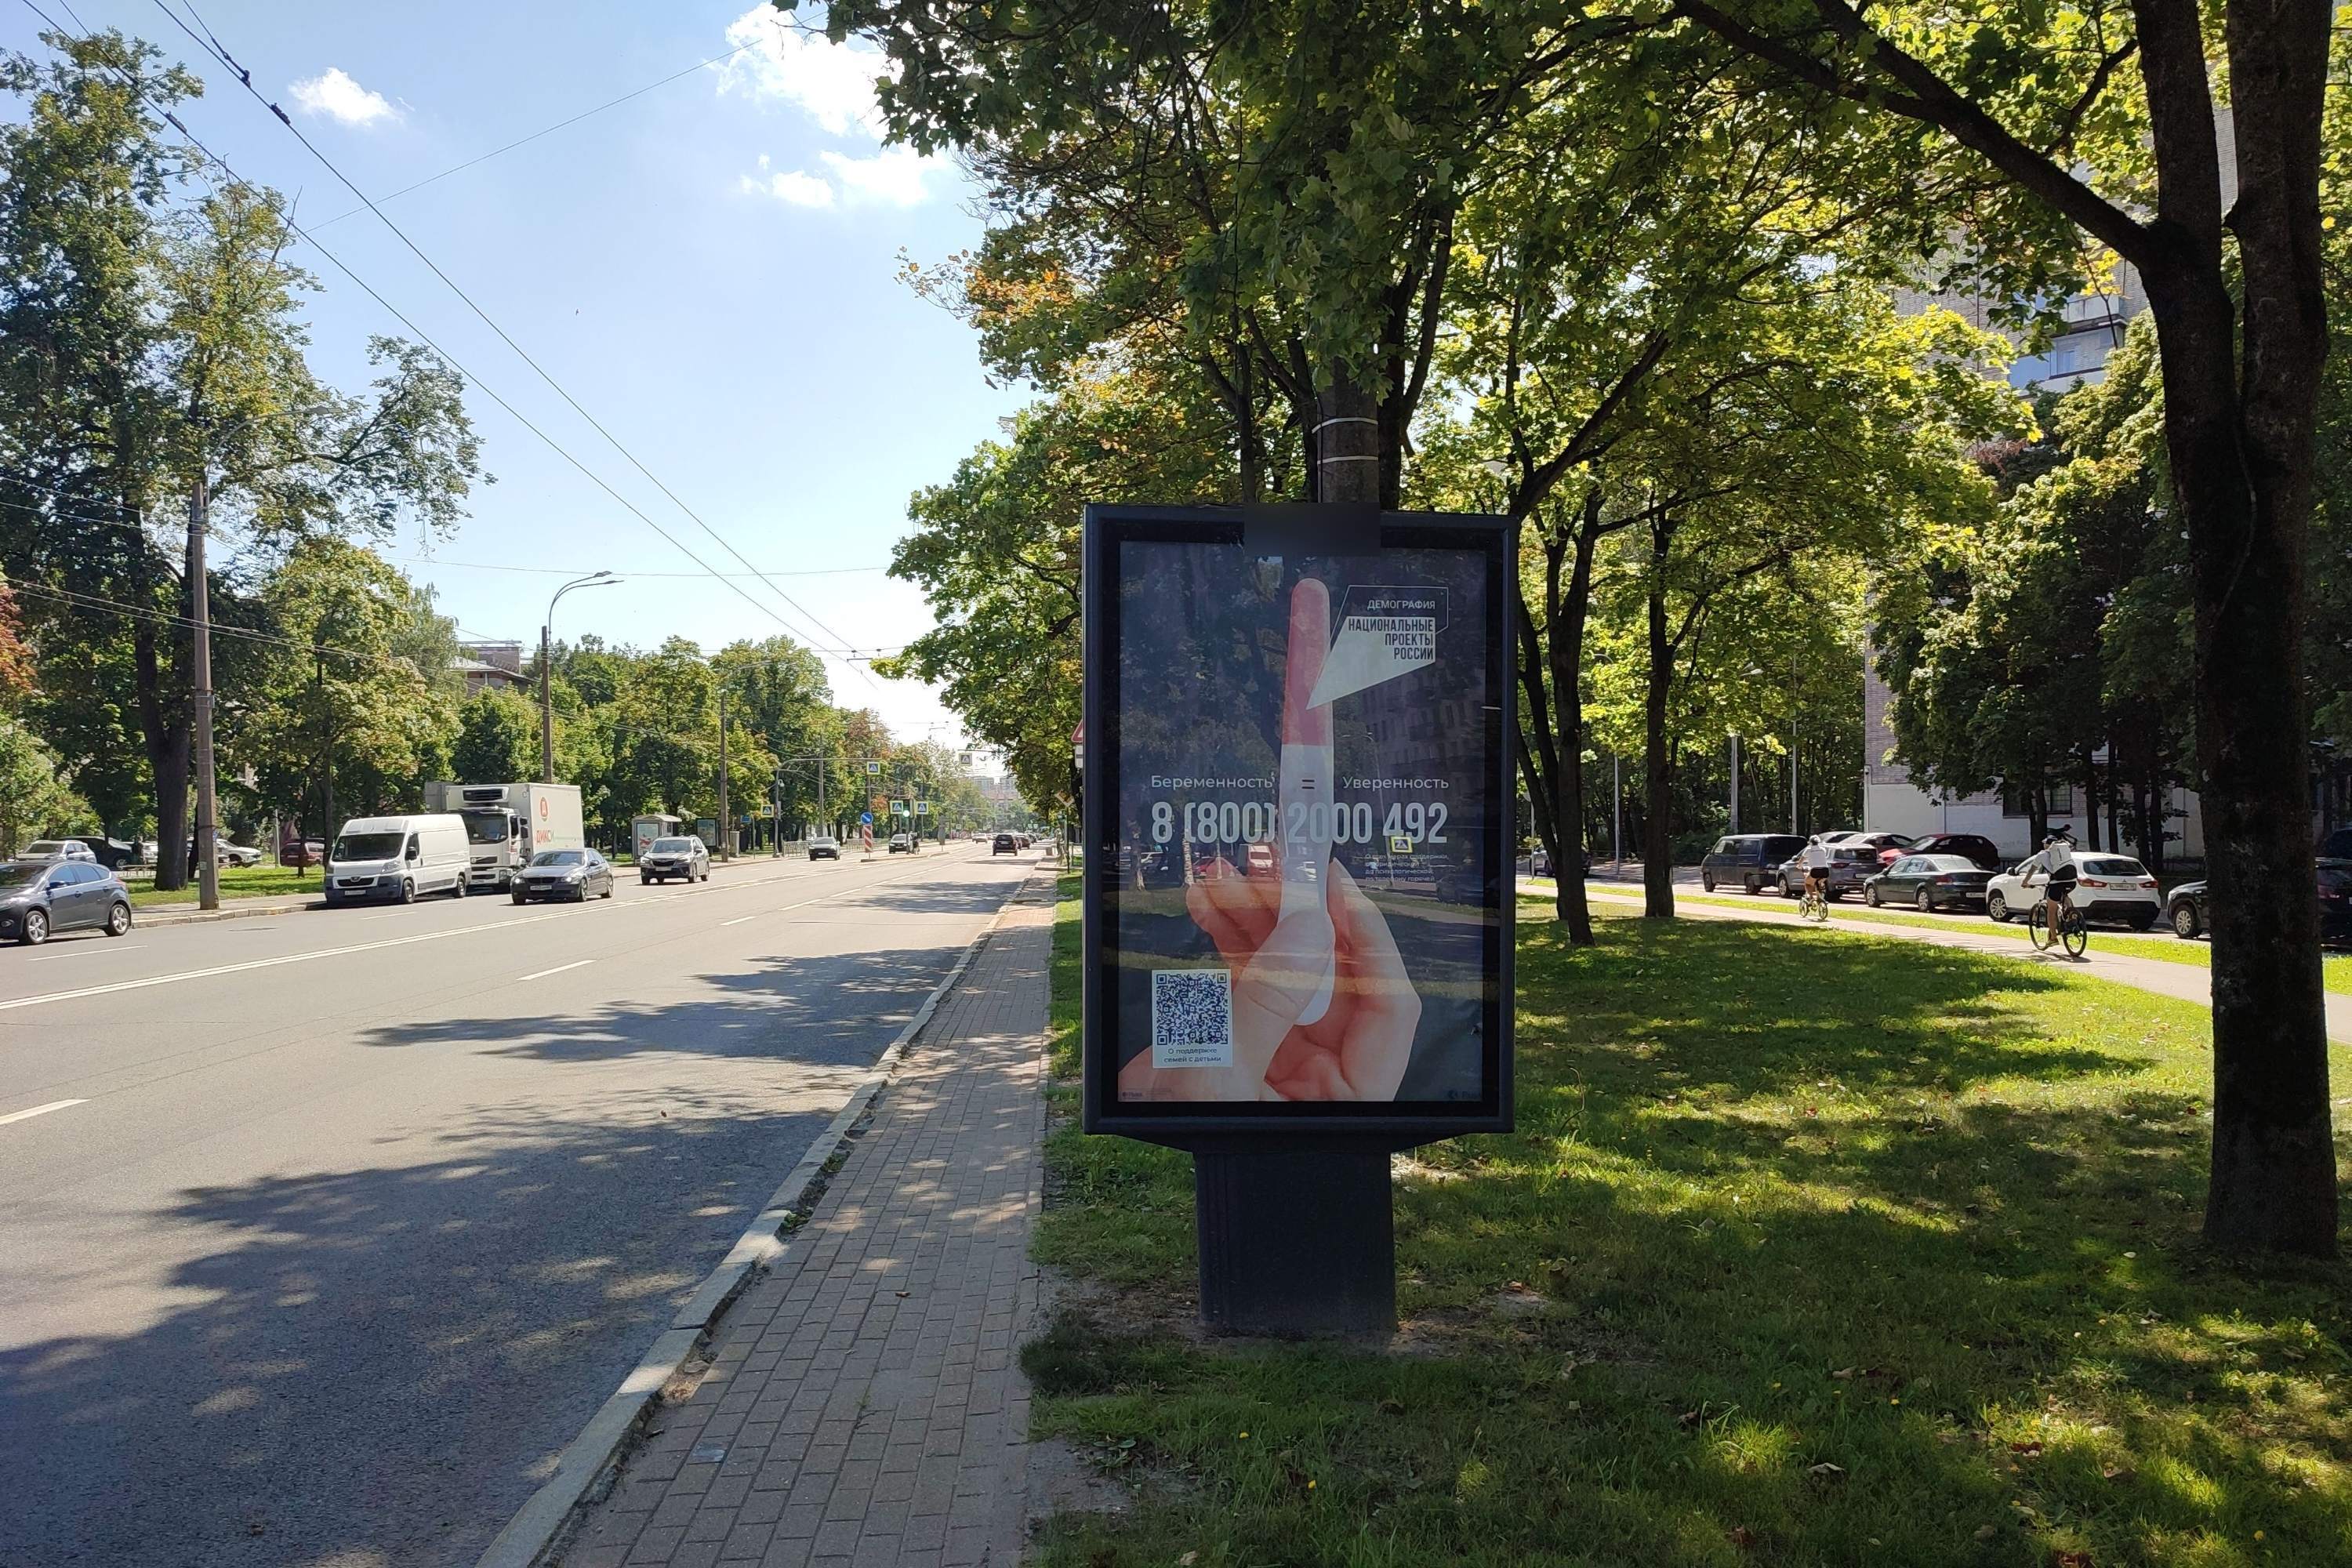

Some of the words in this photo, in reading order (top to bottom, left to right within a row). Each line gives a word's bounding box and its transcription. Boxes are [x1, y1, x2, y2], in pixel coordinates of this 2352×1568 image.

[1367, 600, 1436, 610] ДЕМОГРАФИЯ
[1348, 619, 1434, 633] НАЦИОНАЛЬНЫЕ
[1385, 633, 1434, 646] ПРОЕКТЫ
[1393, 647, 1434, 660] РОССИИ
[1151, 775, 1273, 790] Беременность
[1342, 776, 1450, 791] Уверенность
[1152, 801, 1173, 844] 8
[1287, 802, 1373, 844] 2000
[1382, 802, 1448, 844] 492
